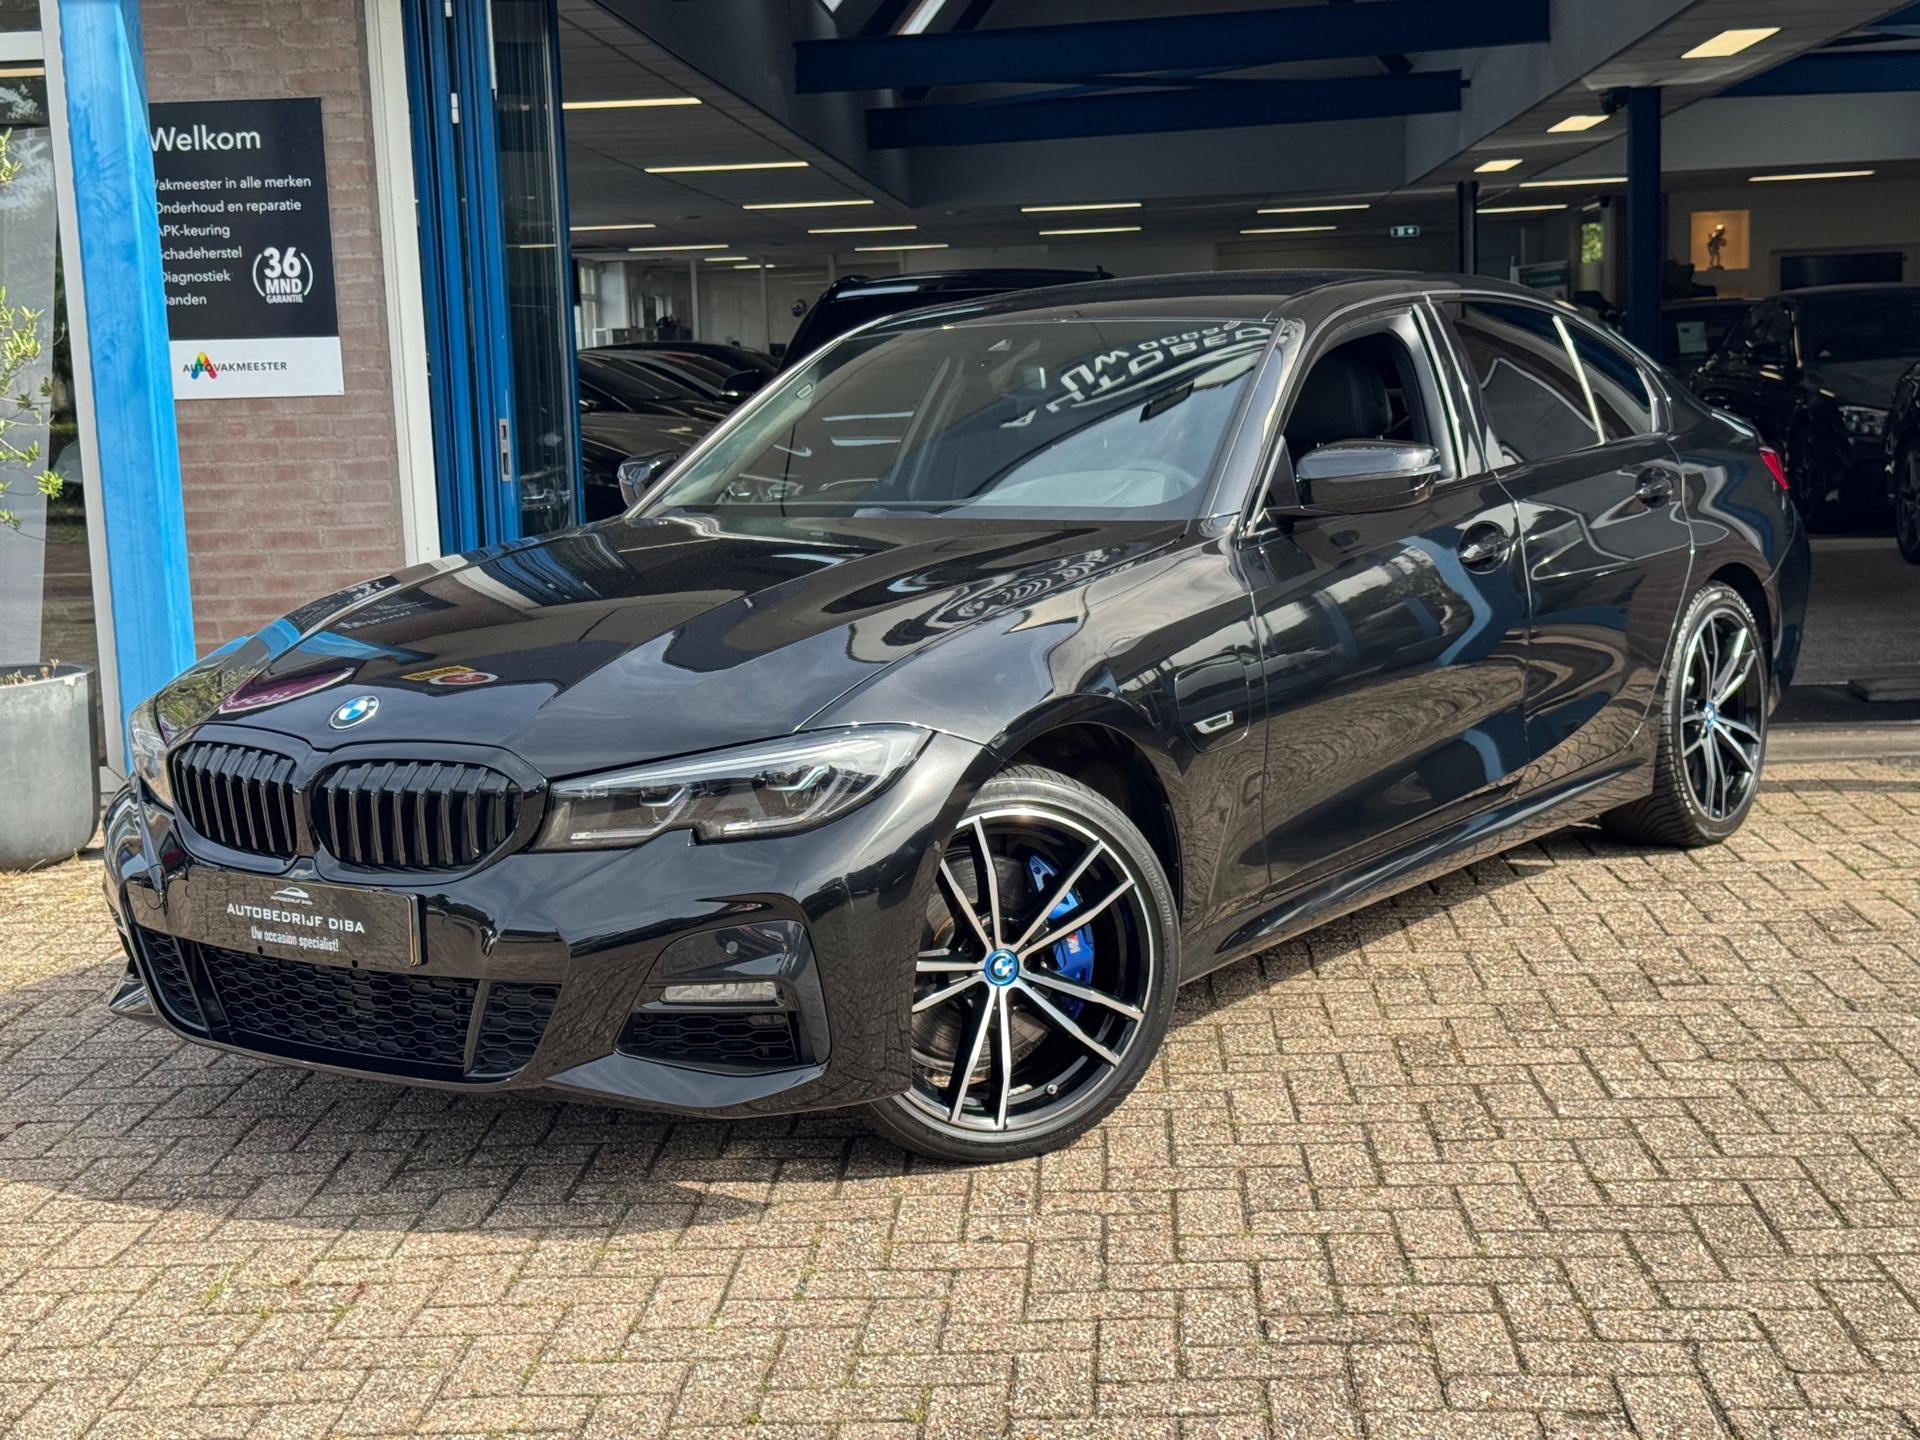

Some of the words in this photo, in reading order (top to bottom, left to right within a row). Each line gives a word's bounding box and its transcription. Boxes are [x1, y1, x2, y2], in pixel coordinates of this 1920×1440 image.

[150, 124, 261, 152] Welkom
[225, 177, 237, 189] in
[240, 175, 262, 189] alle
[264, 174, 312, 188] merken
[227, 202, 243, 213] en
[246, 198, 302, 214] reparatie
[263, 247, 301, 278] 36
[265, 278, 302, 294] MND
[266, 294, 303, 304] GARANTIE
[182, 361, 288, 373] AUTOVAKMEESTER
[227, 903, 323, 927] AUTOBEDRIJF
[328, 917, 365, 933] DIBA
[251, 925, 262, 939] Uw
[264, 931, 297, 946] occasion
[298, 936, 339, 952] specialist!
